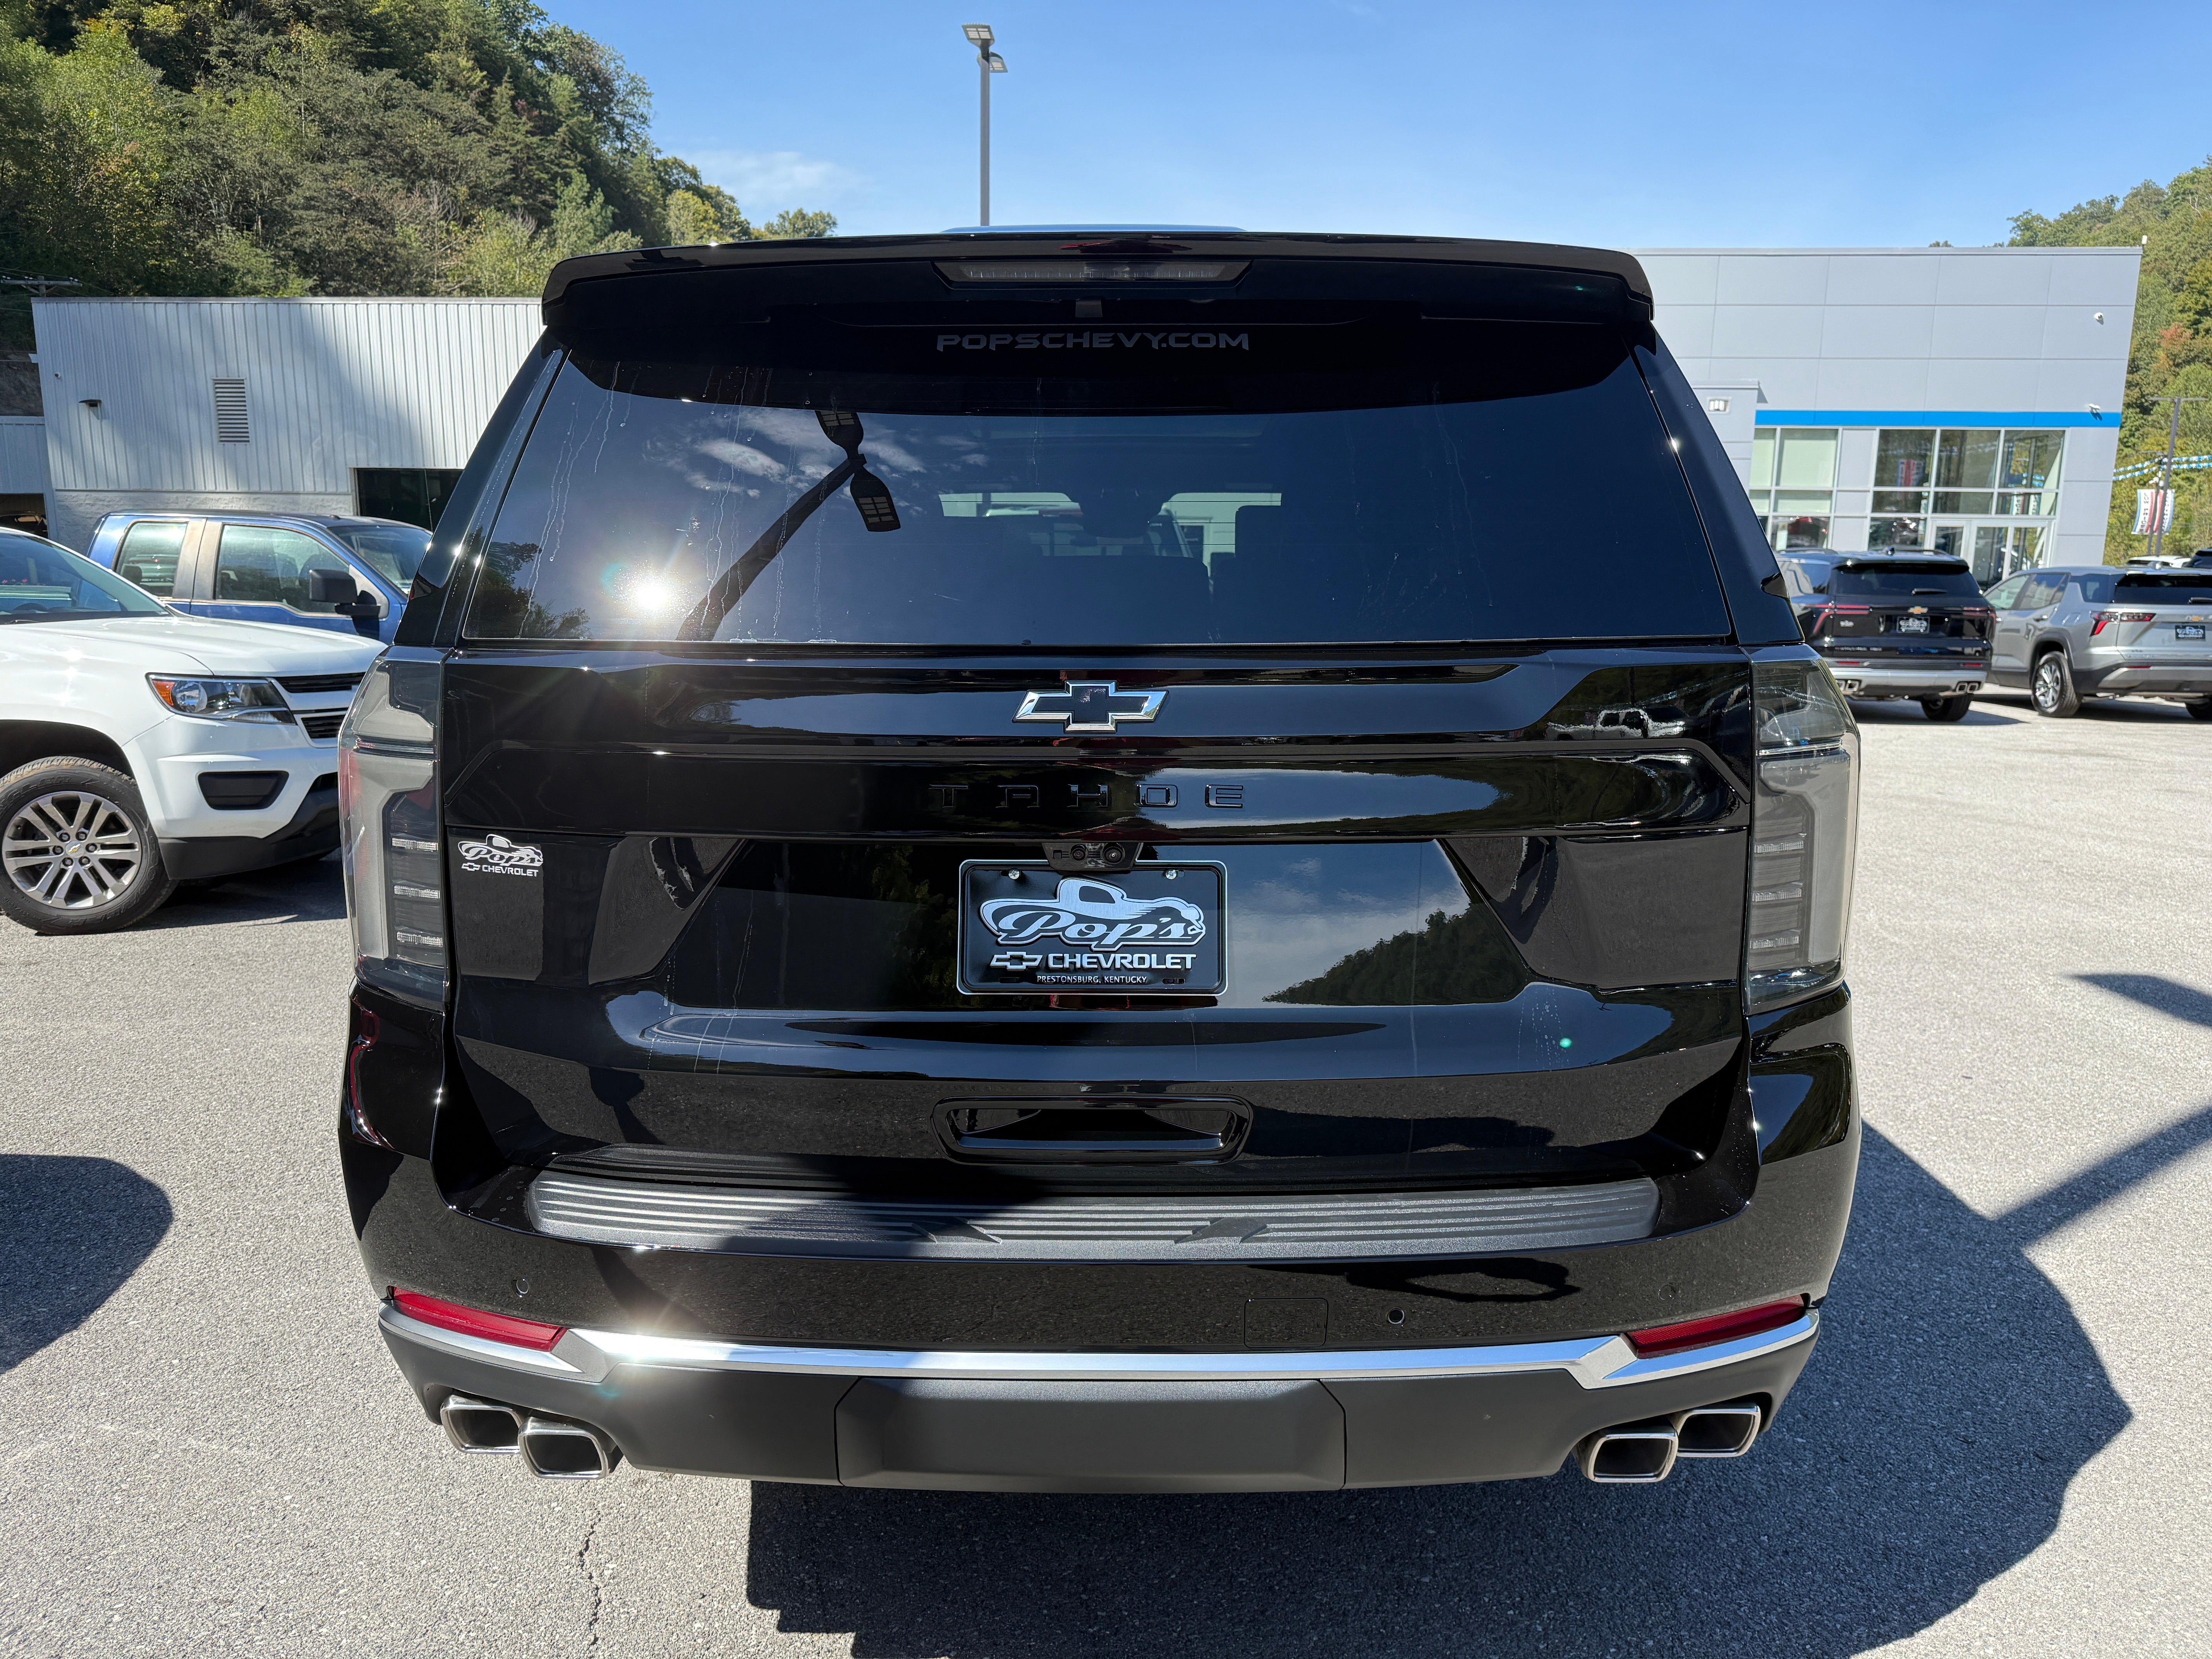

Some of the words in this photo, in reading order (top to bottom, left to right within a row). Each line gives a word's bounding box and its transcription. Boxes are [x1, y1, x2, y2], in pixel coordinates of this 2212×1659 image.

[937, 331, 1249, 351] POPSCHEVY.COM
[929, 784, 1243, 808] TAHOE
[482, 864, 539, 877] CHEVROLET
[998, 911, 1192, 945] Pop's
[1048, 953, 1197, 969] CHEVROLET
[1037, 975, 1101, 984] PRESTONSBURG,
[1104, 975, 1147, 984] KENTUCKY
